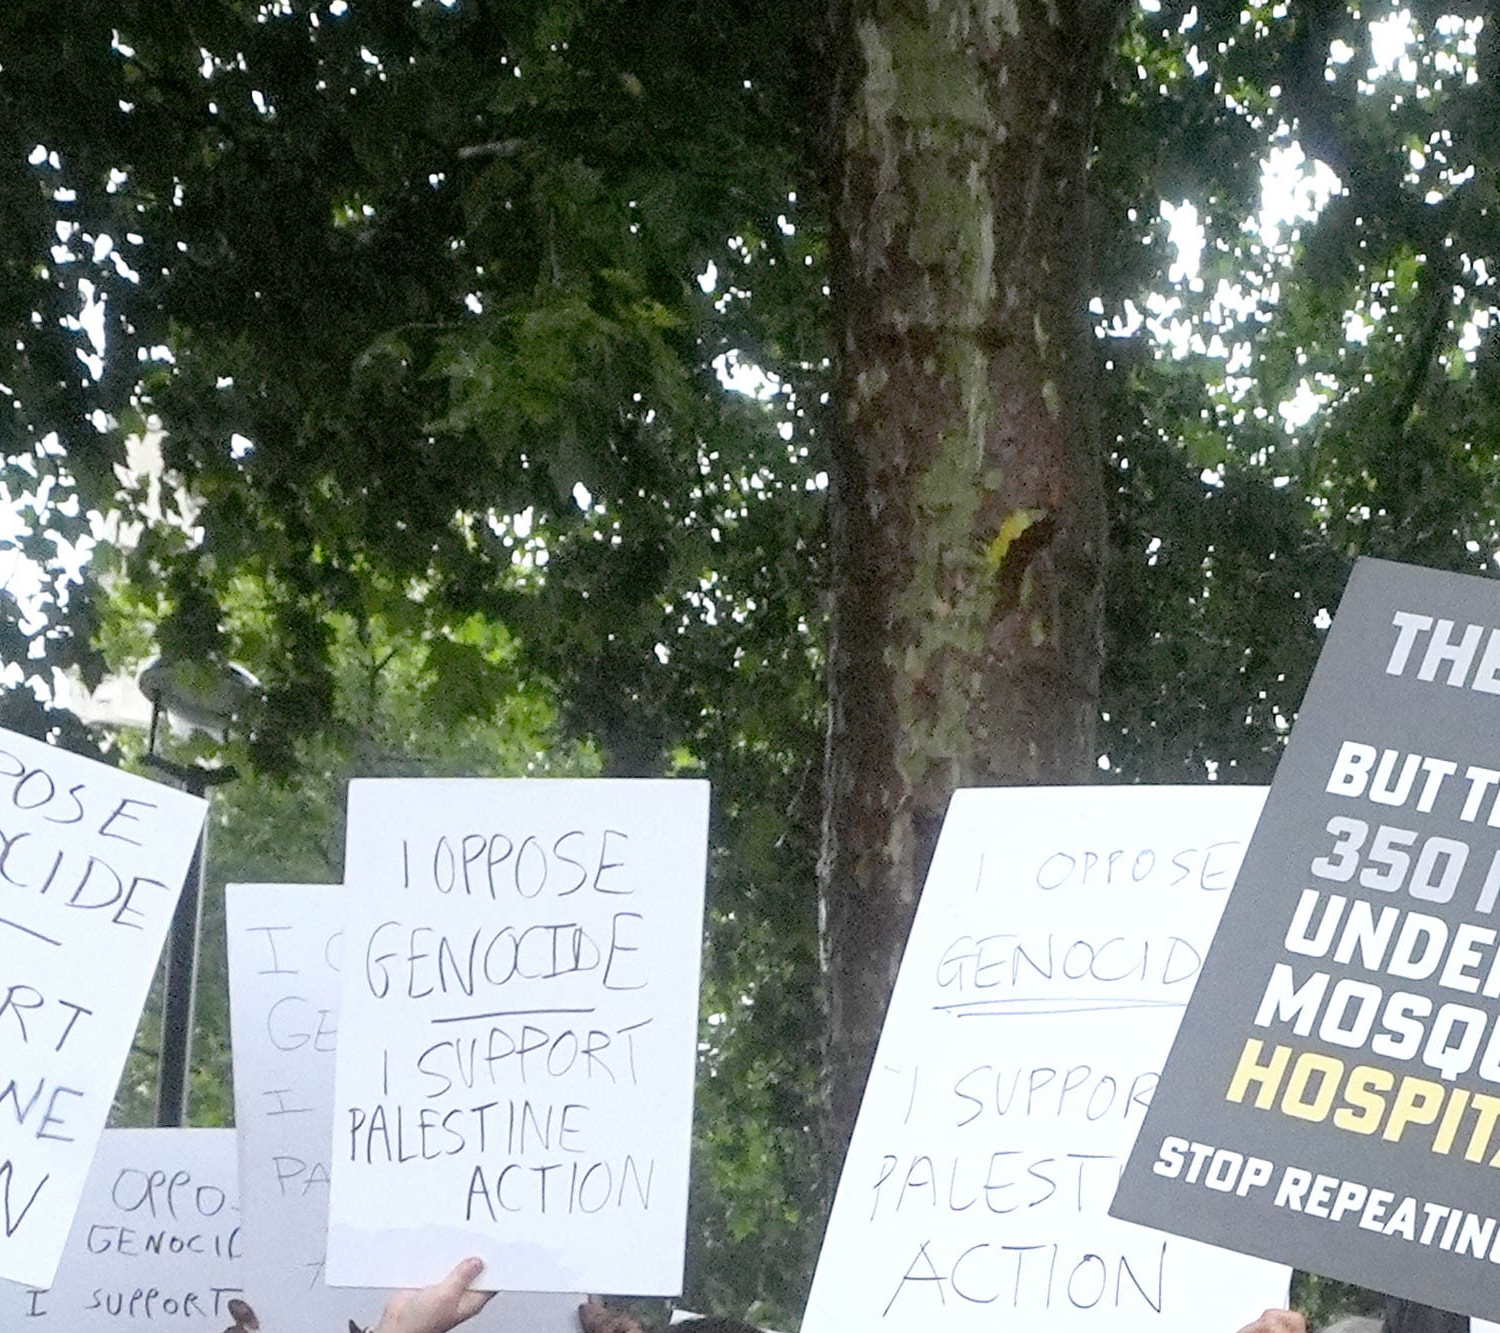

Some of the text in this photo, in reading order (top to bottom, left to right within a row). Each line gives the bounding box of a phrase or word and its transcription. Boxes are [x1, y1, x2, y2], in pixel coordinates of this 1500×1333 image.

[1325, 741, 1461, 808] BUT
[401, 830, 636, 899] I OPPOSE
[976, 841, 1240, 892] I OPPOSE
[1311, 817, 1470, 901] 350
[367, 913, 647, 999] GENOCIDE
[936, 934, 1202, 990] GENOCID
[381, 1018, 653, 1098] I SUPPORT
[956, 1065, 1161, 1126] SUPPOR
[350, 1100, 589, 1162] PALESTINE
[111, 1167, 238, 1215] OPPO
[467, 1158, 654, 1223] ACTION
[870, 1151, 1122, 1221] PALEST
[1151, 1136, 1275, 1198] STOP
[86, 1225, 242, 1260] GENOCI
[26, 1288, 242, 1317] I SUPPORT
[882, 1240, 1167, 1318] ACTION
